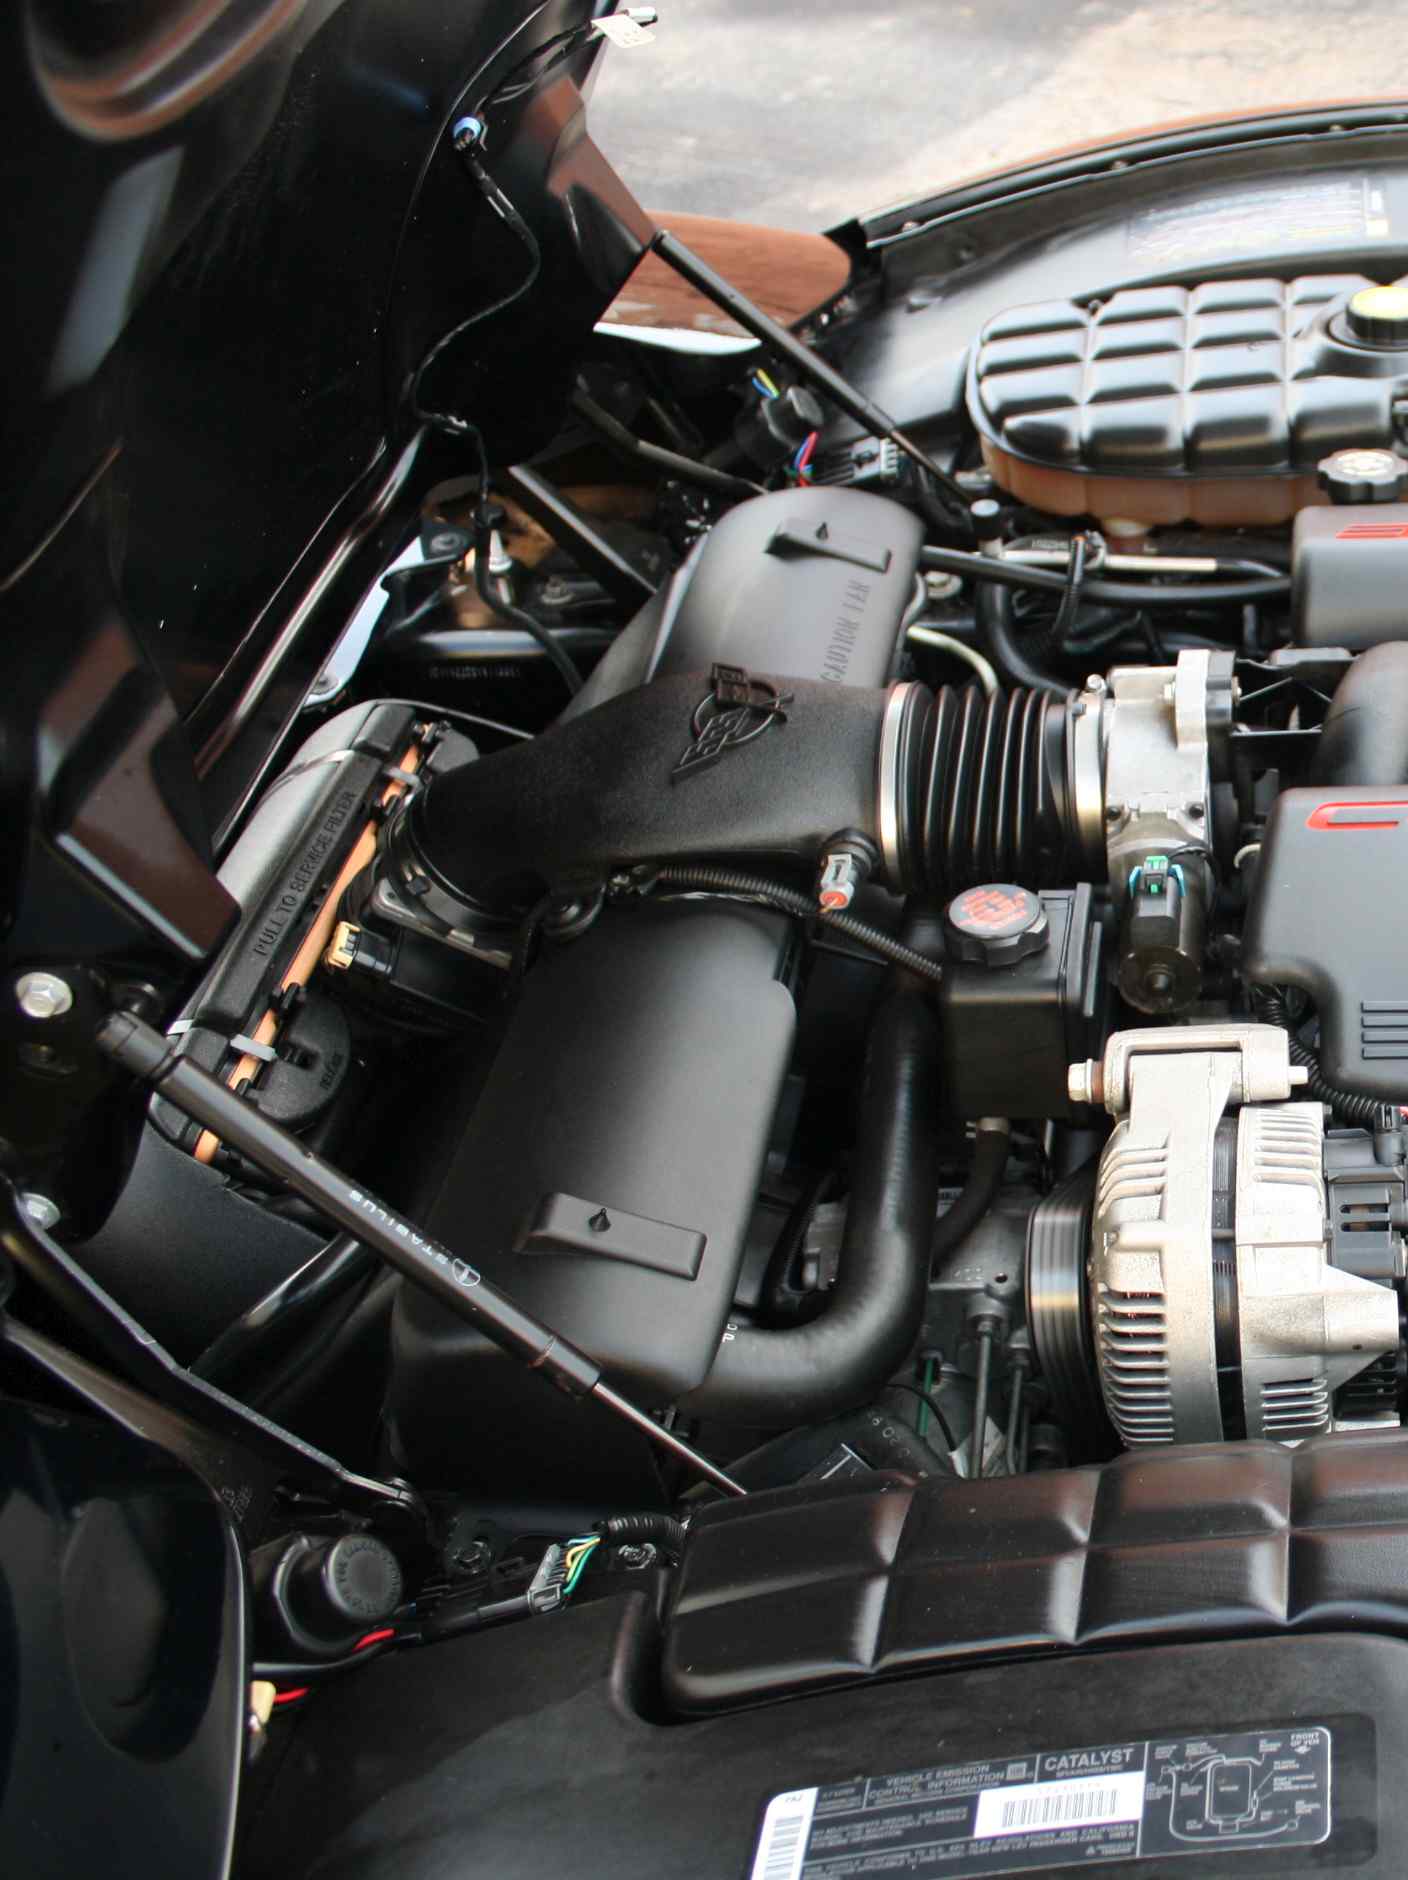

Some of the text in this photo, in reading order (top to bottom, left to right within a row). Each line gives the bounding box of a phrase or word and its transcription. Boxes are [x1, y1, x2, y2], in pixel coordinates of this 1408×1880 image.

[252, 790, 356, 957] PULL TO SERVICE FILTER
[1044, 1748, 1135, 1771] CATALYST
